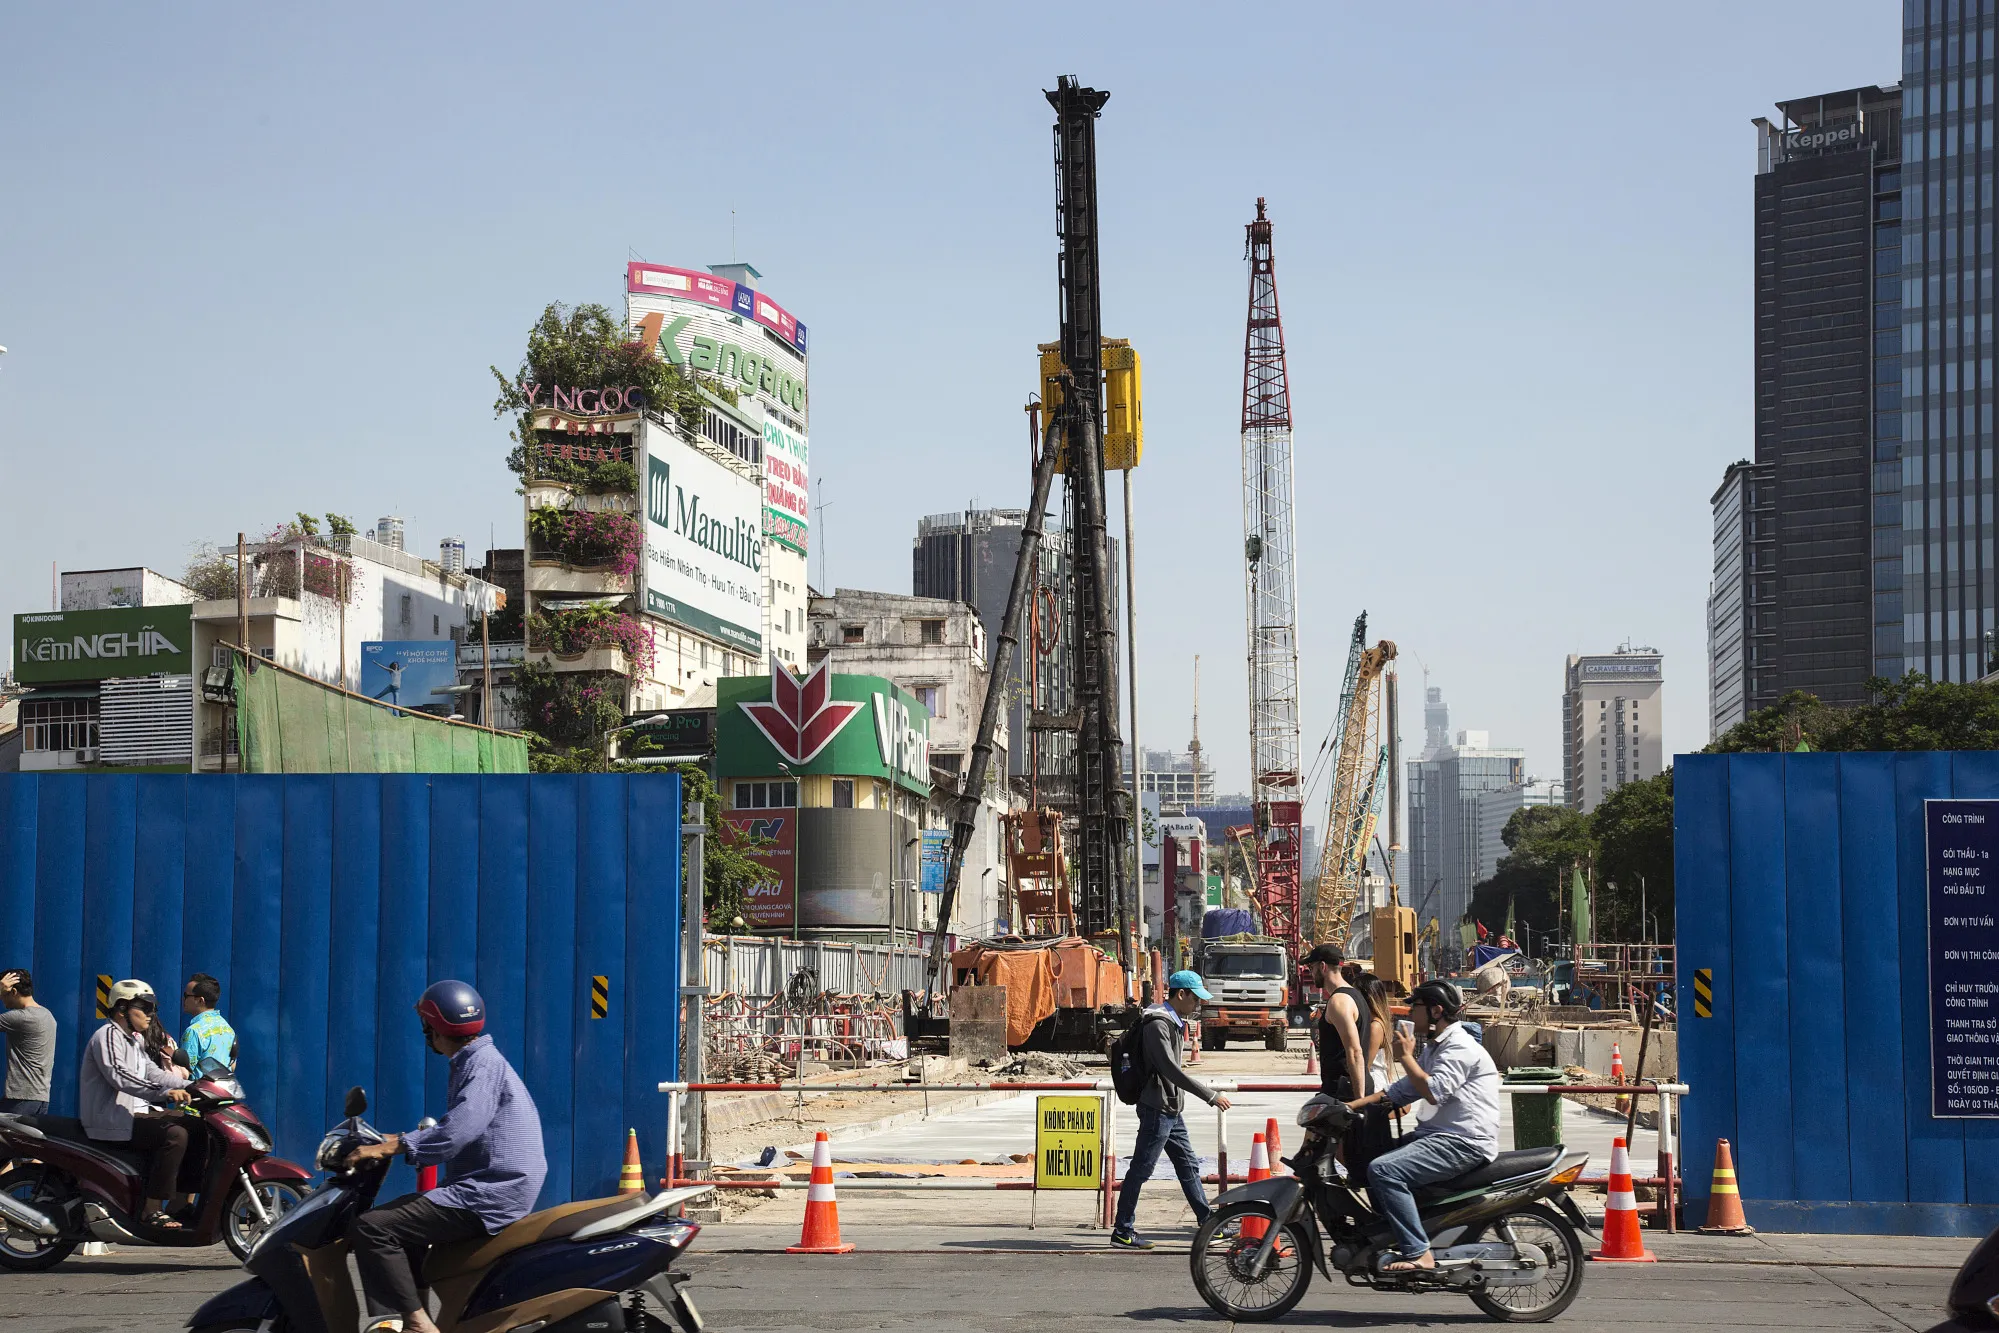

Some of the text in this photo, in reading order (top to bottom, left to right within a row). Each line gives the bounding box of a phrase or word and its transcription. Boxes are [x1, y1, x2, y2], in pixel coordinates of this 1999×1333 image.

[1786, 123, 1856, 149] Keppel
[634, 311, 806, 413] Kangaroo
[764, 421, 784, 450] CHO
[766, 454, 791, 482] TREO
[768, 481, 797, 513] QUẢNG
[674, 485, 760, 573] Manulife
[660, 549, 676, 571] Hiểm
[677, 558, 694, 579] Nhân
[695, 566, 707, 588] Thọ
[676, 715, 701, 730] Pro
[871, 691, 931, 787] VPBank
[1942, 813, 1985, 824] CÔNG TRÌNH
[1981, 850, 1989, 859] 1a
[1943, 867, 1980, 878] HẠNG MỤC
[1975, 884, 1986, 895] TƯ
[1944, 914, 1994, 928] ĐƠN VỊ TƯ VẤN
[1944, 949, 1960, 960] ĐƠN
[1960, 950, 1968, 962] VỊ
[1969, 951, 1981, 960] THI
[1958, 984, 1974, 993] HUY
[1945, 996, 1989, 1008] CÔNG TRÌNH
[1946, 1019, 1970, 1029] THANH
[1971, 1019, 1986, 1029] TRA
[1946, 1033, 1964, 1043] GIAO
[1964, 1032, 1990, 1044] THÔNG
[1964, 1056, 1982, 1066] GIAN
[1983, 1056, 1995, 1066] THI
[1947, 1067, 1971, 1080] QUYẾT
[1972, 1070, 1990, 1082] ĐỊNH
[1947, 1081, 1961, 1094] SỐ:
[1962, 1085, 1990, 1095] 105/QĐ
[1948, 1097, 1970, 1108] NGÀY
[1971, 1099, 1981, 1109] 03
[1043, 1106, 1066, 1130] KHÔNG
[1045, 1139, 1093, 1177] MIỄN VÀO
